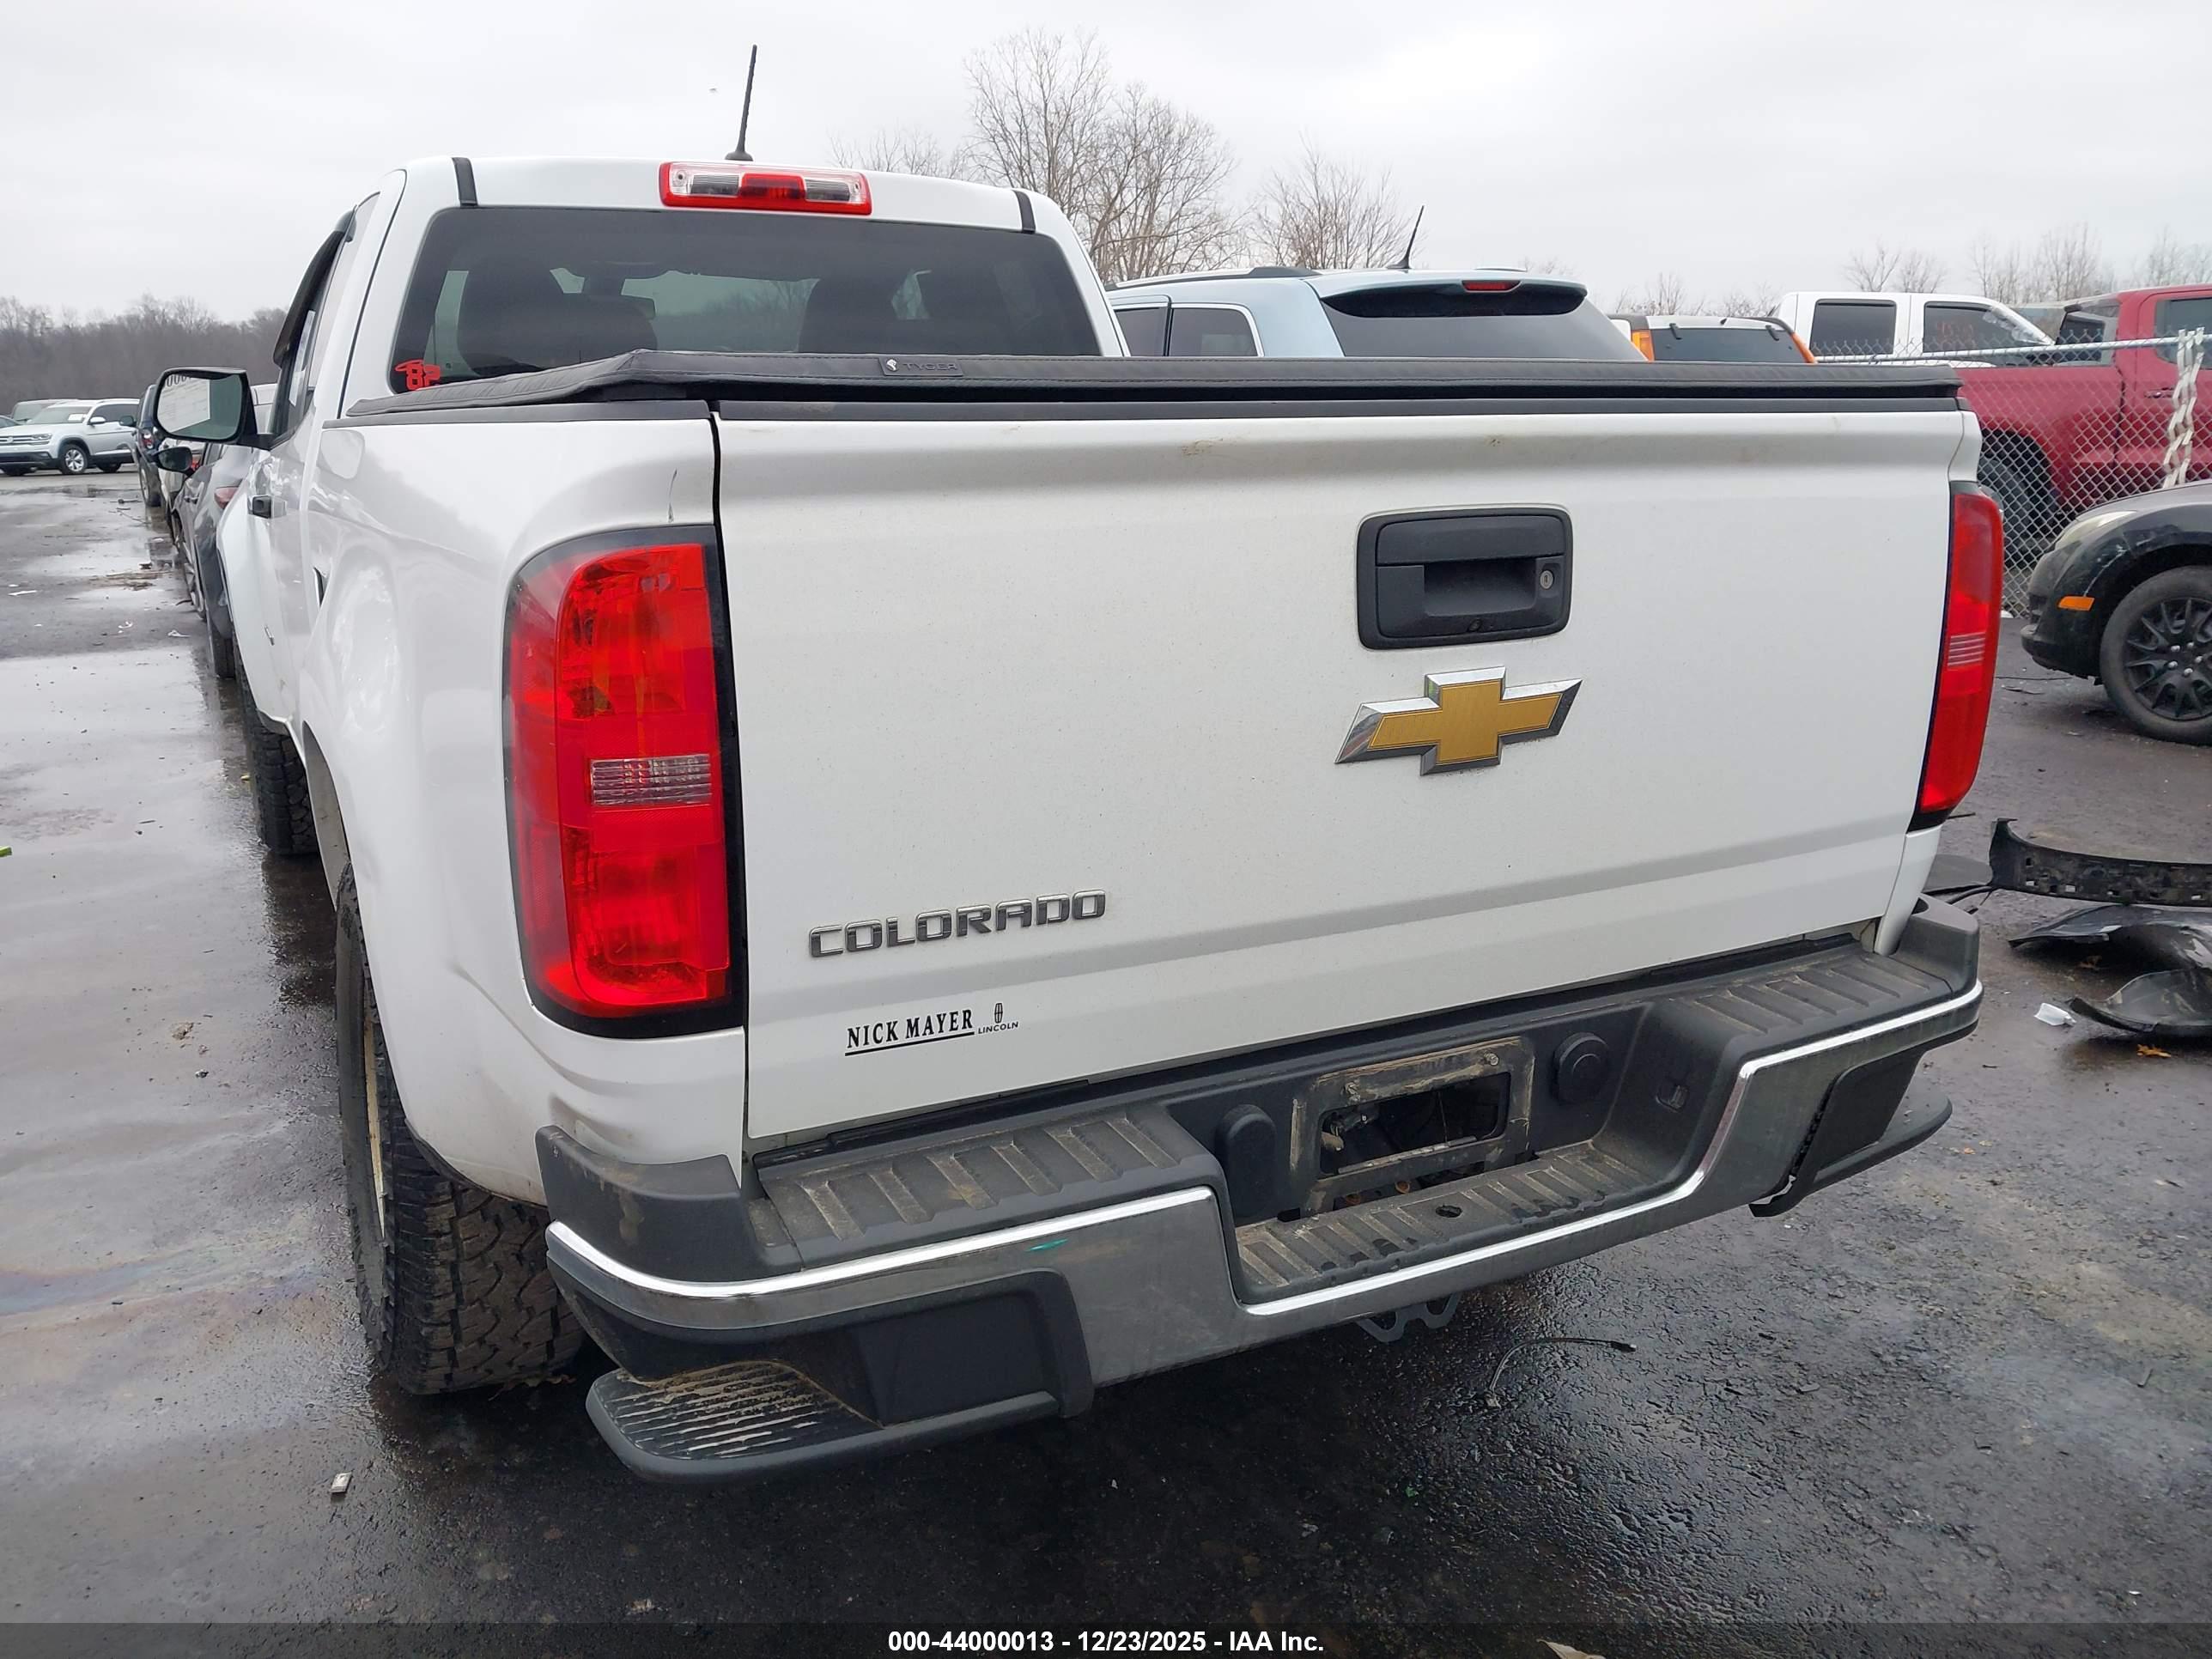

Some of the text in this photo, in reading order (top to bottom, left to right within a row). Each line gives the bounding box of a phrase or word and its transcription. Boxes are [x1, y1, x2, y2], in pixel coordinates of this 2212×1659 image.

[902, 362, 958, 371] TYGER
[809, 889, 1106, 958] COLORADO
[847, 1008, 973, 1049] NICK MAYER
[977, 1021, 1019, 1035] LINCOLN
